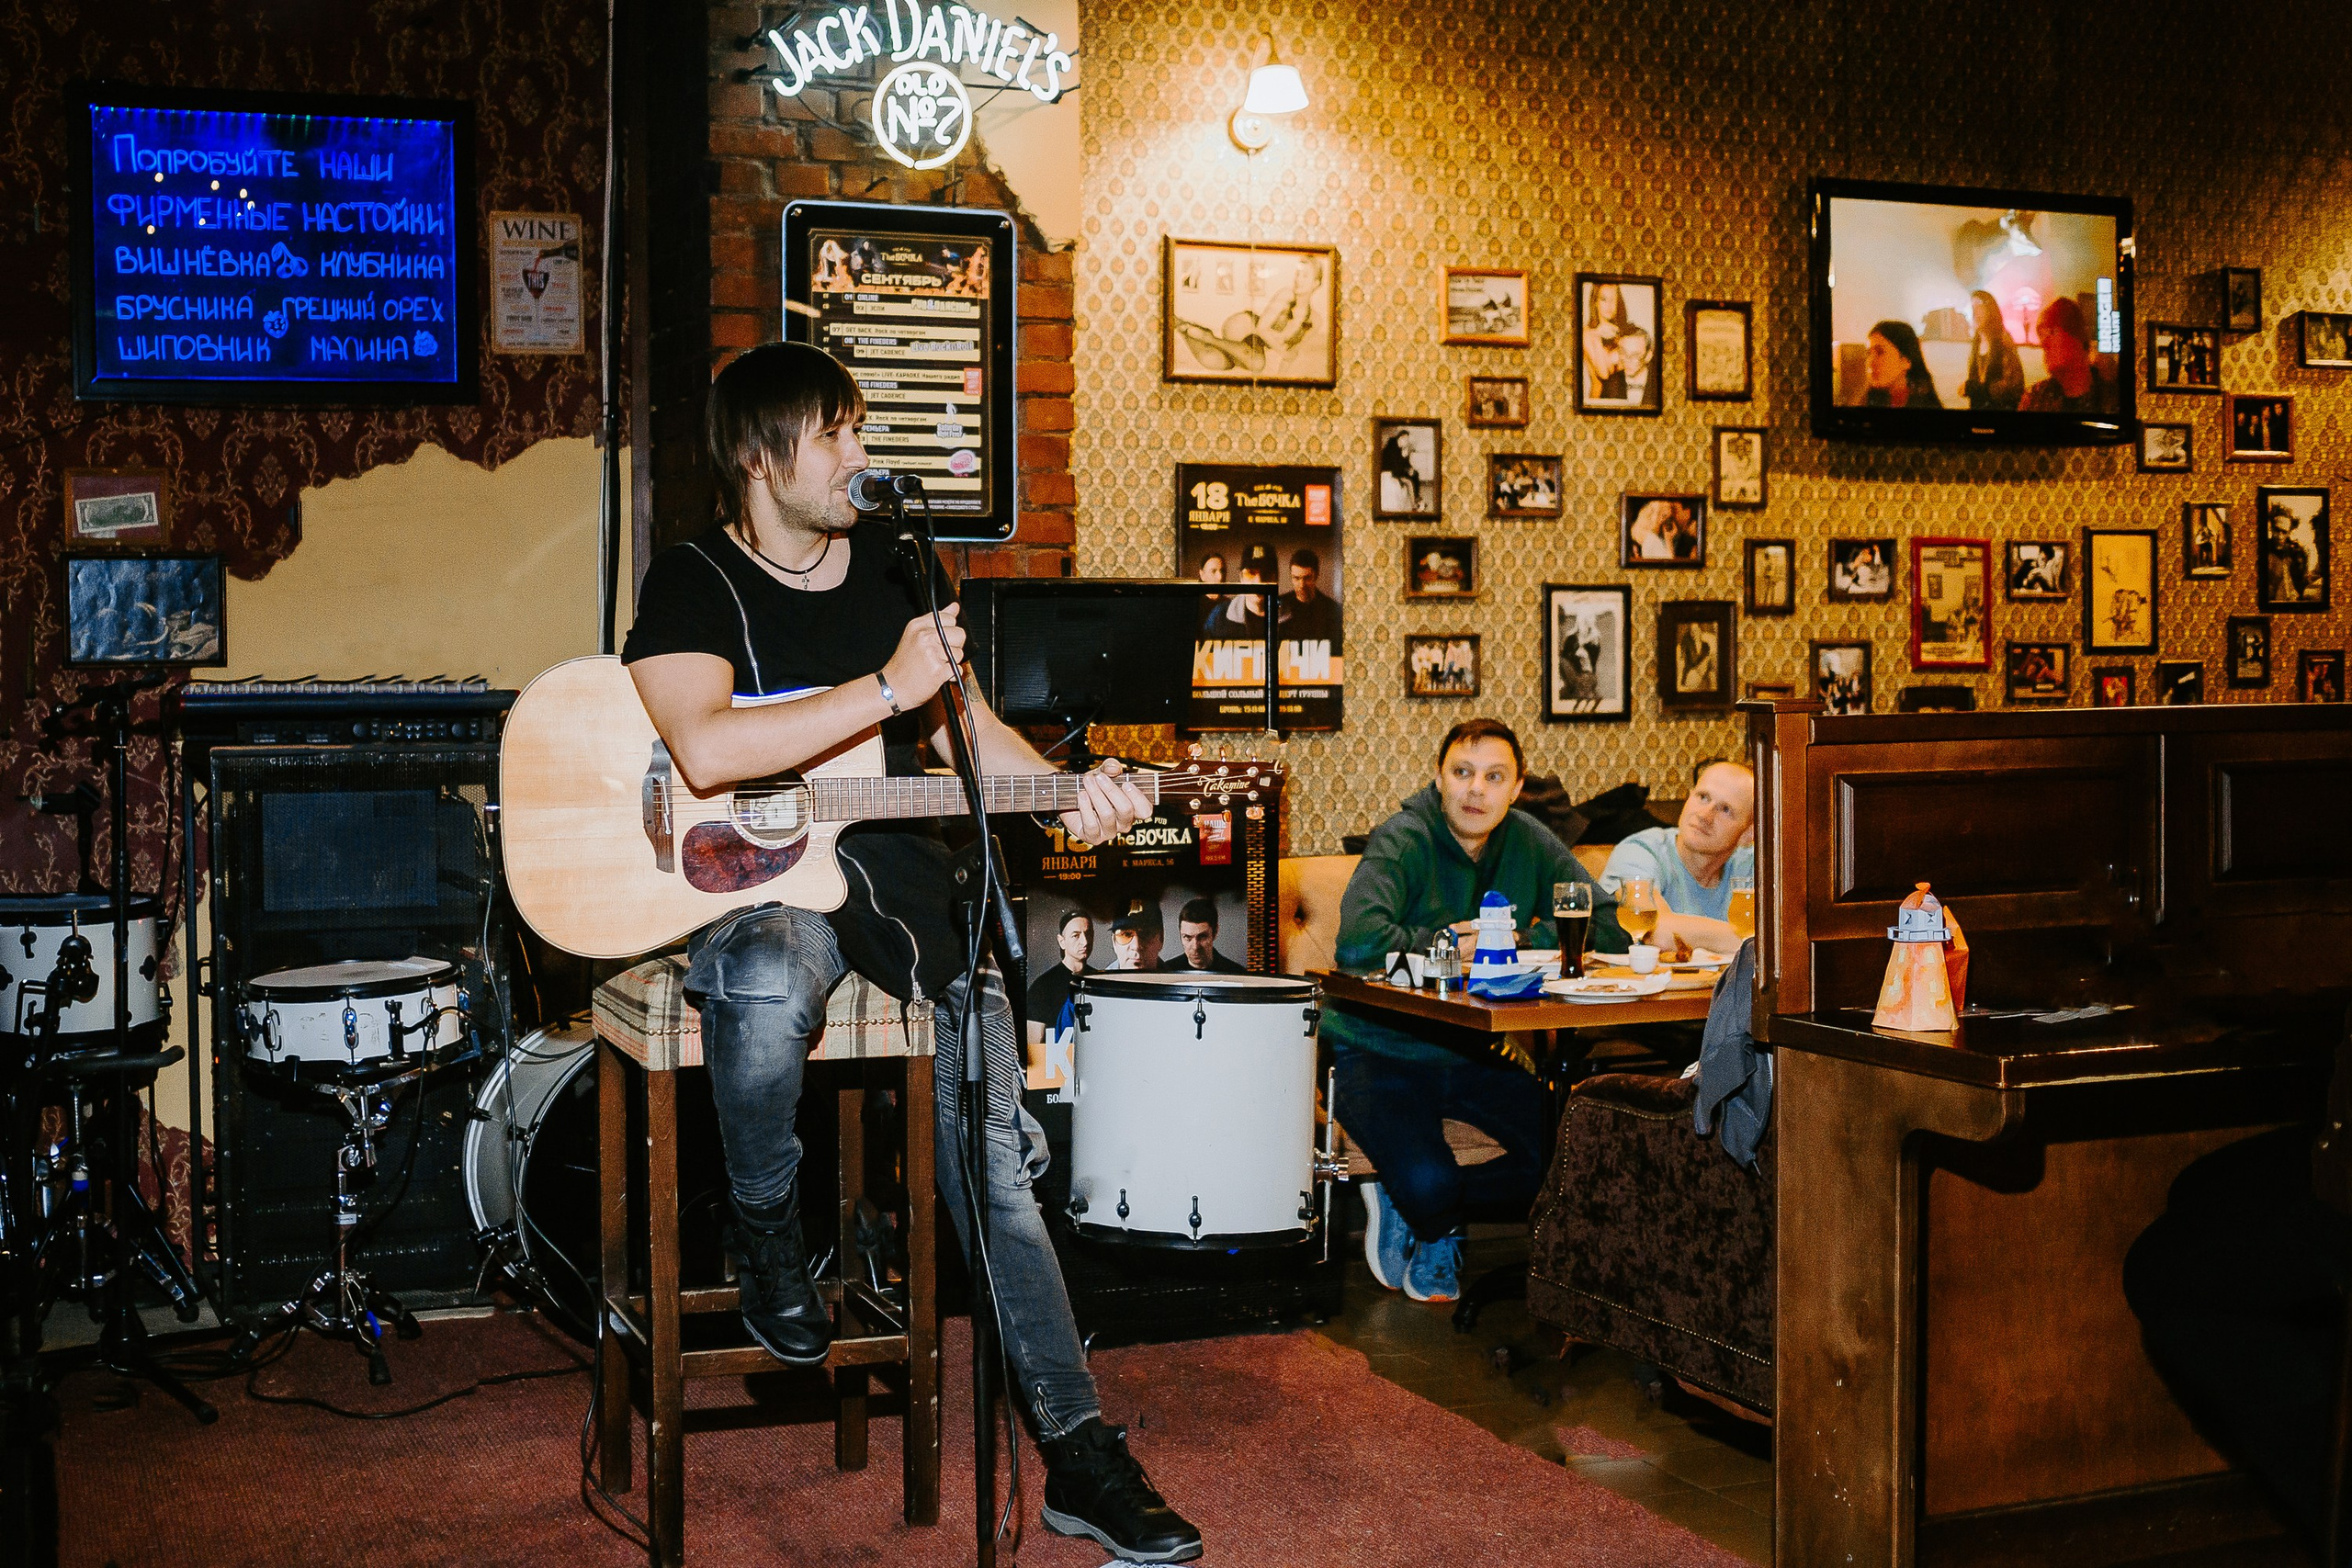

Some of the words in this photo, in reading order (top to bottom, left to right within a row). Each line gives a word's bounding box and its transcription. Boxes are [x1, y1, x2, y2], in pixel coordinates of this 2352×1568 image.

[768, 6, 882, 96] JACK
[885, 0, 1072, 101] DANIEL'S
[894, 73, 948, 96] OLD
[320, 152, 394, 181] НАШИ
[107, 194, 293, 231] ФИРМЕННЫЕ
[302, 197, 445, 236] НАСТОЙКИ
[115, 245, 271, 276] ВИШНЁВКА
[320, 251, 445, 279] КЛУБНИКА
[861, 273, 943, 287] СЕНТЯБРЬ
[116, 295, 254, 321] БРУСНИКА
[283, 290, 376, 322] ГРЕЦКИЙ
[382, 297, 445, 322] ОРЕХ
[118, 333, 272, 362] ШИПОВНИК
[311, 335, 409, 362] МАЛИНА
[857, 337, 869, 345] THE
[886, 458, 900, 467] Floyd
[1190, 481, 1229, 511] 18
[1197, 776, 1250, 797] Takamine
[1154, 817, 1168, 826] PUB
[1042, 855, 1098, 871] ЯНВАРЯ
[1058, 872, 1081, 880] 19:00
